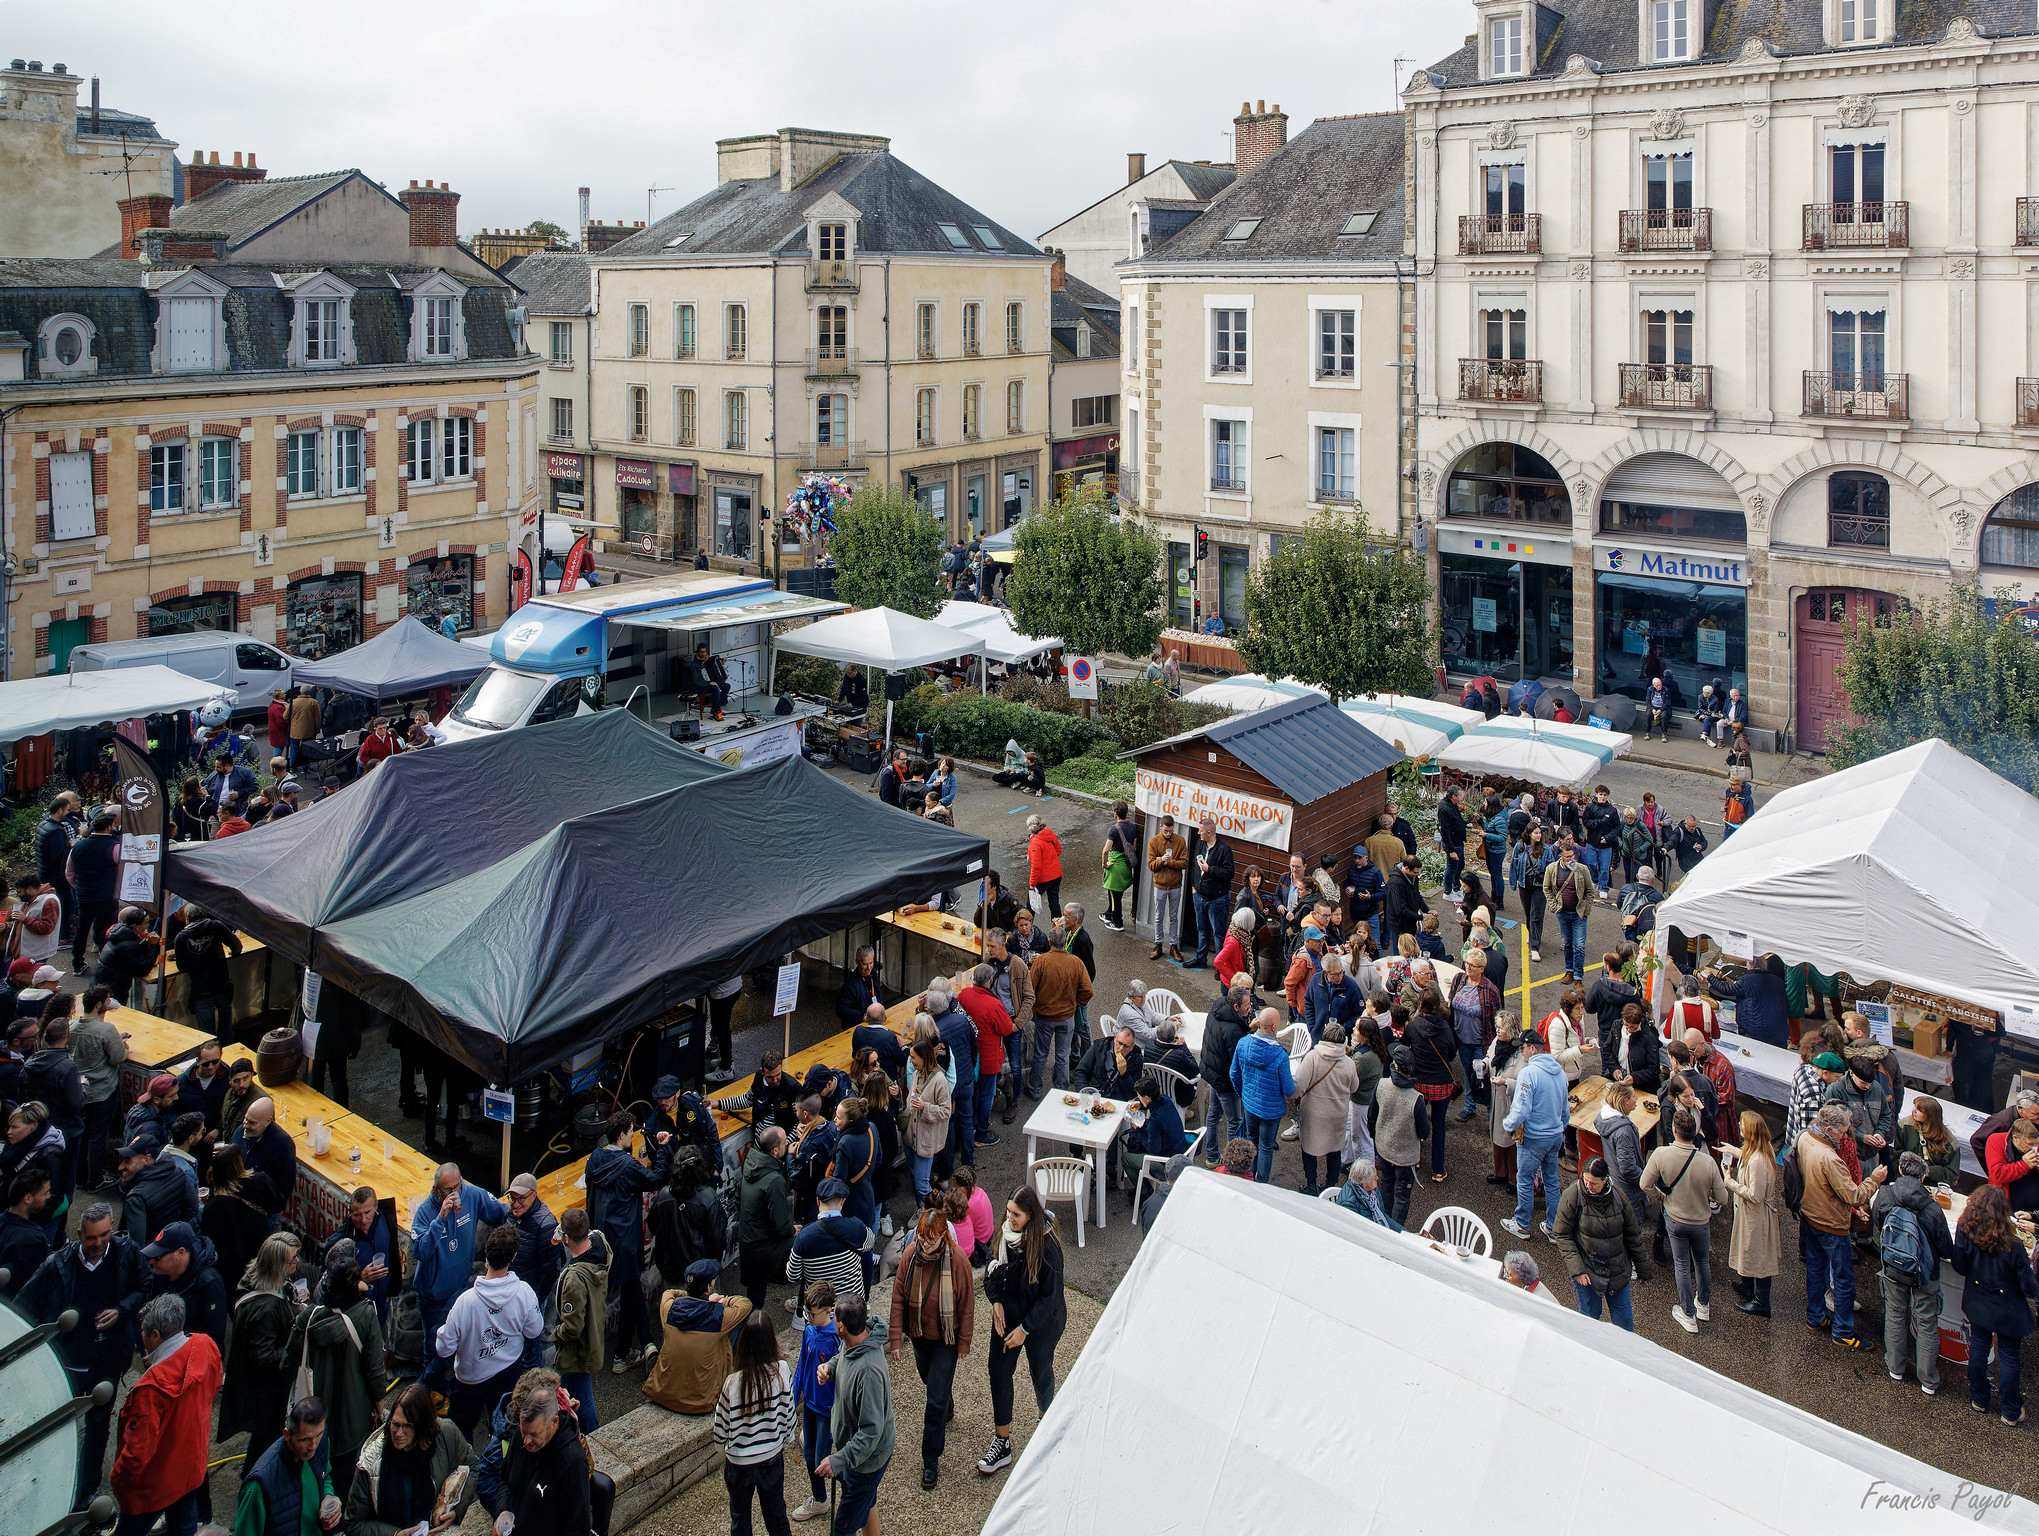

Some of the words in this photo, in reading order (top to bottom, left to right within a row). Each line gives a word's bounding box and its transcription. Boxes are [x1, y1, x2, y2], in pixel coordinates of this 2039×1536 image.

[1639, 552, 1741, 582] Matmut
[1162, 799, 1180, 817] de
[1192, 789, 1209, 806] du
[1215, 794, 1285, 825] MARRON
[1892, 990, 1937, 1008] GALETTES
[1945, 1005, 1996, 1025] SAUCISSES
